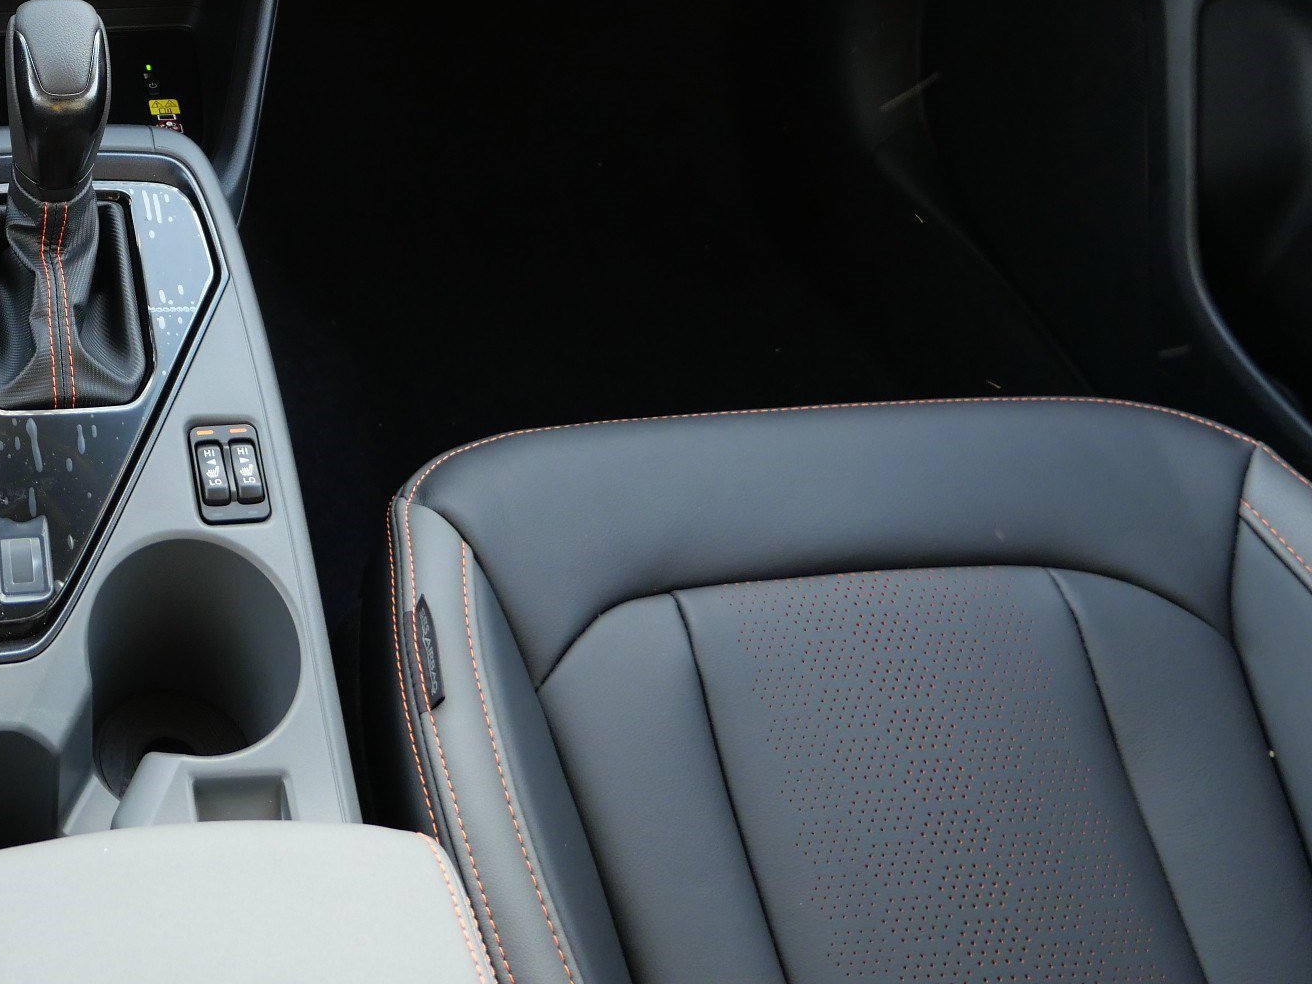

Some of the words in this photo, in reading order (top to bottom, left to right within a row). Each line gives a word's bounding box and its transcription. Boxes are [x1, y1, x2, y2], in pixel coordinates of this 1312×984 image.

[203, 449, 215, 458] HI
[236, 447, 249, 455] HI
[209, 478, 223, 486] LO
[243, 476, 256, 484] LO
